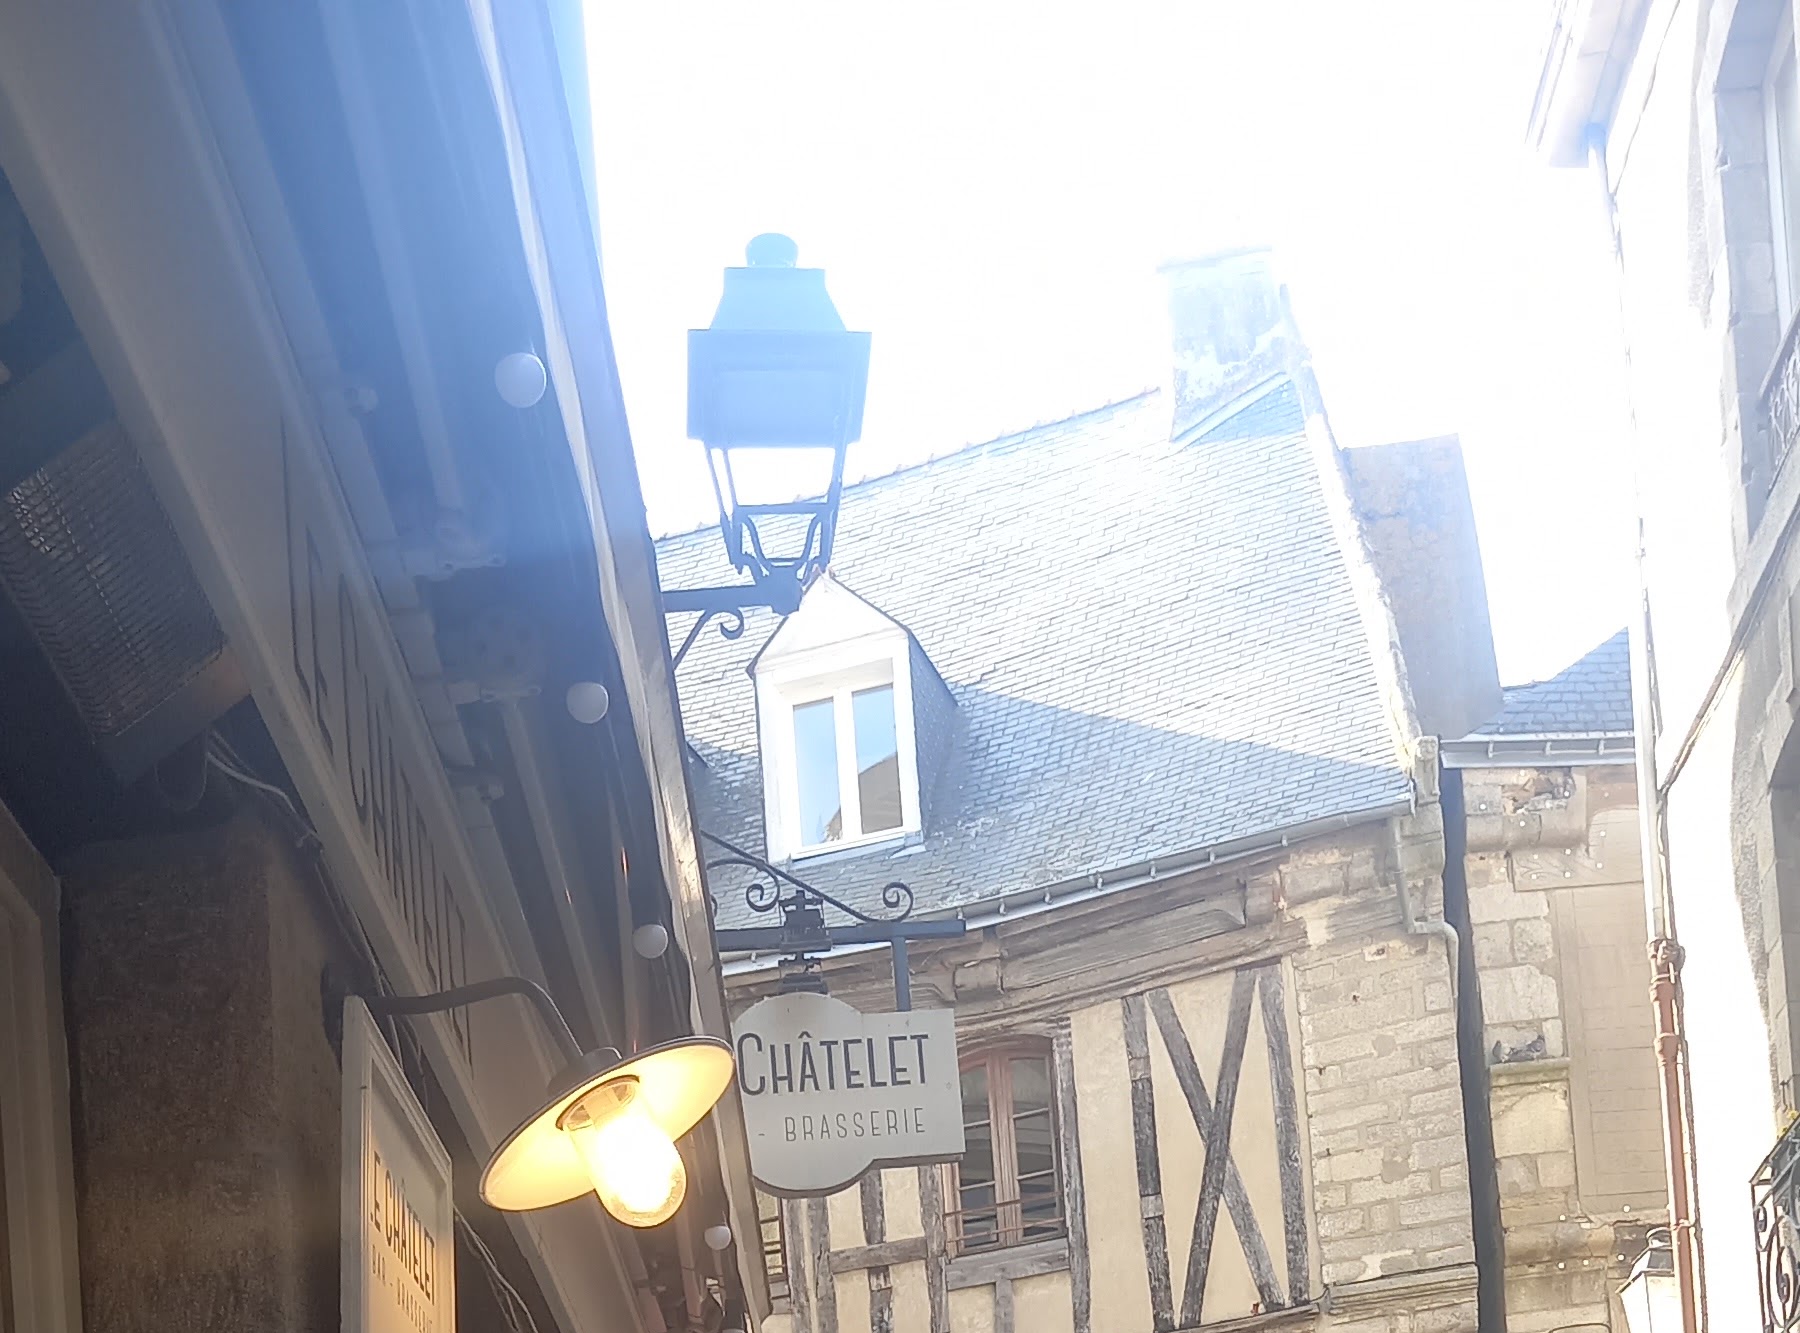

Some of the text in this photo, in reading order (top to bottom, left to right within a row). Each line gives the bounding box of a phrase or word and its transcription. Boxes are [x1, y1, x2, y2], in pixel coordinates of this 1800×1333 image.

[280, 413, 333, 757] LE
[737, 1031, 929, 1096] CHÂTELET
[785, 1108, 926, 1142] BRASSERIE
[369, 1150, 382, 1232] E
